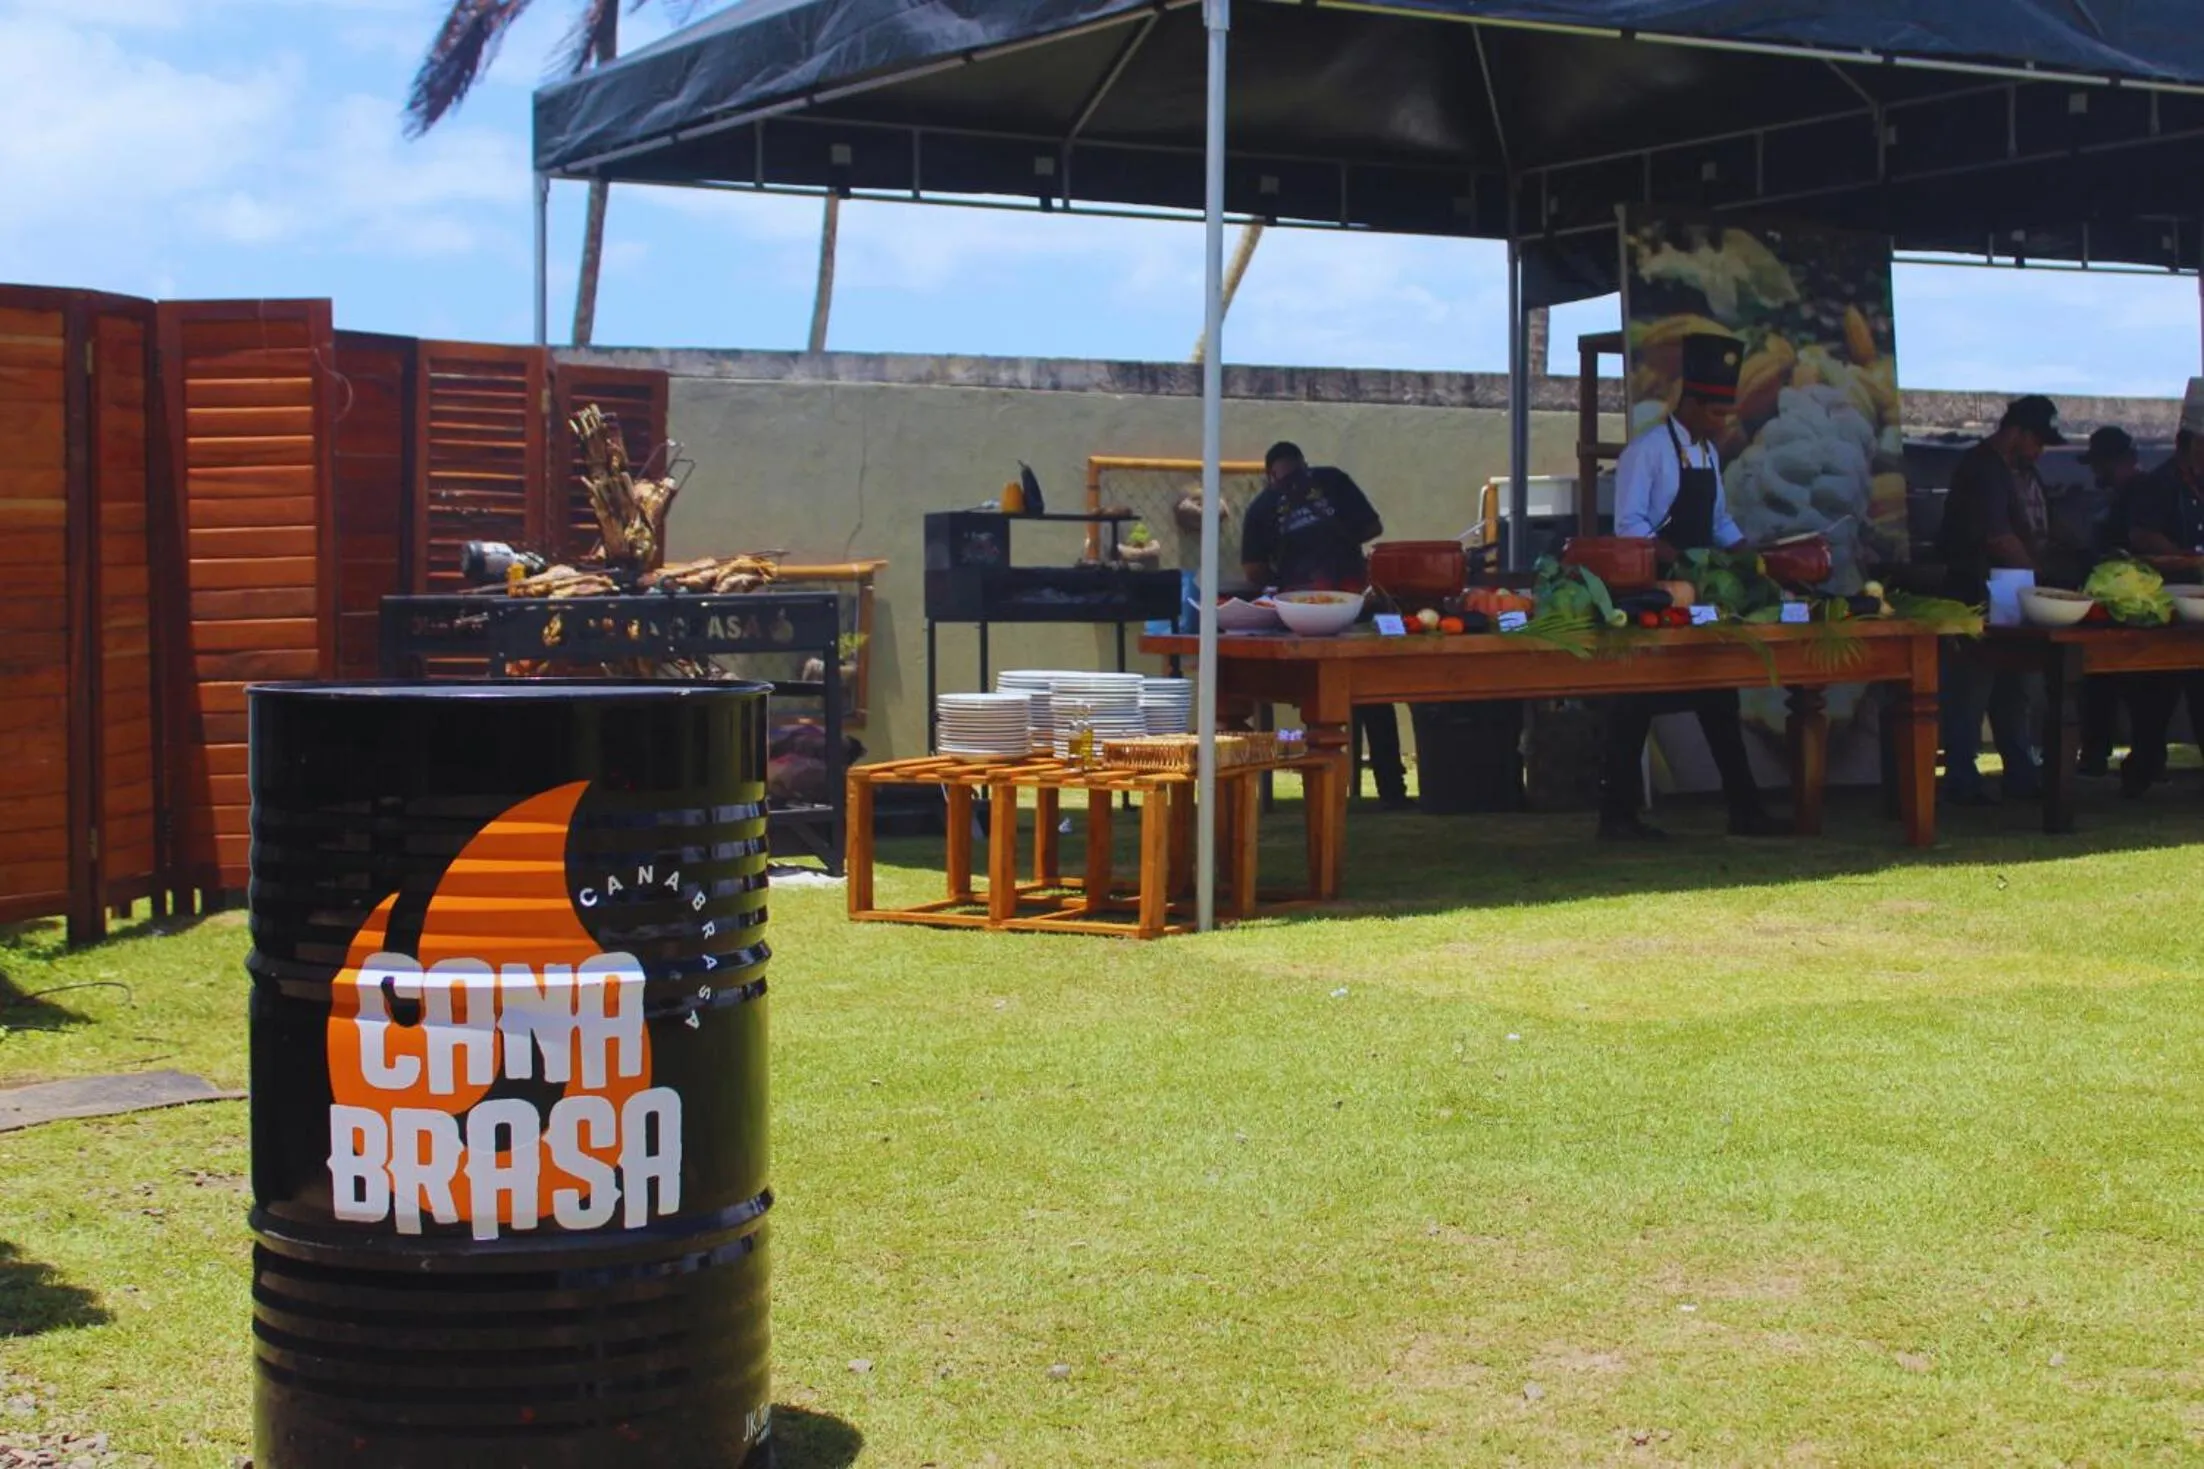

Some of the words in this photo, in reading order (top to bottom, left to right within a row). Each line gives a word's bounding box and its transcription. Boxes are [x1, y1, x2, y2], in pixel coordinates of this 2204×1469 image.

[356, 952, 647, 1096] CANA
[579, 865, 718, 1030] CANABRASA
[327, 1087, 683, 1241] BRASA
